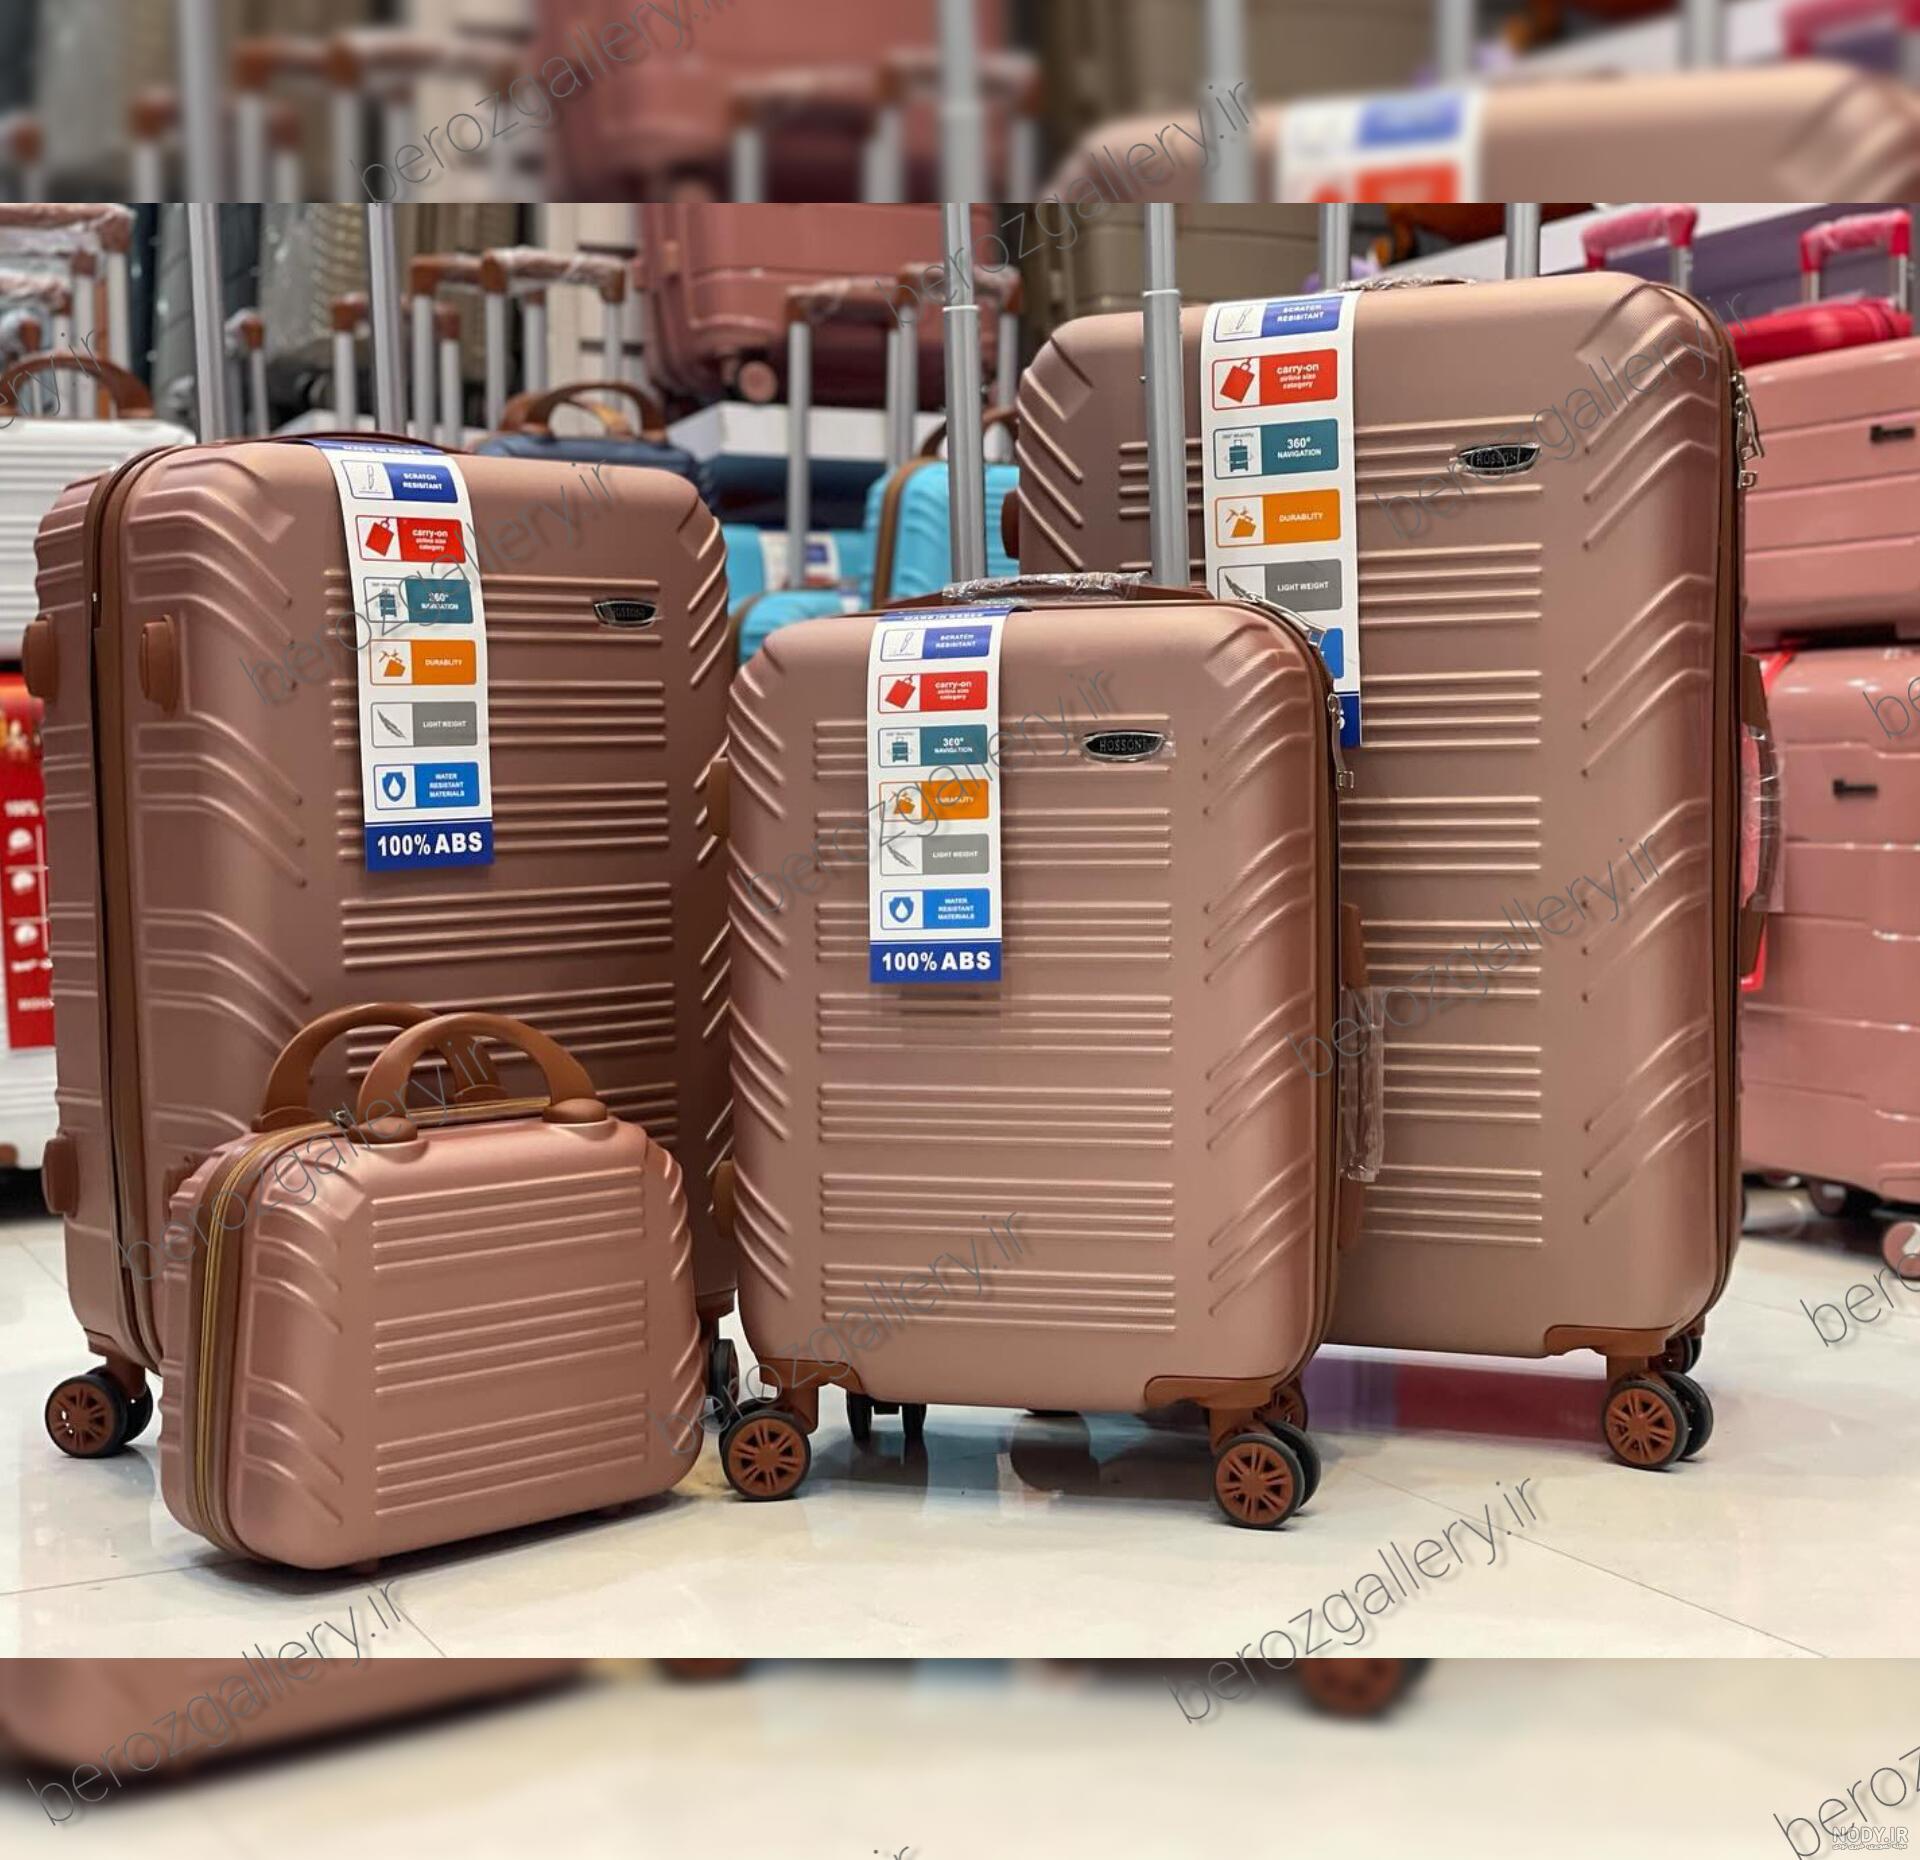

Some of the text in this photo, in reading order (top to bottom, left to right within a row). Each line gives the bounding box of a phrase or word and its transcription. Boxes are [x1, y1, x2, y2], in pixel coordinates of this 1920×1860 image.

[1276, 363, 1319, 375] carry-on
[1286, 436, 1312, 449] 360°
[1277, 448, 1322, 459] NAVIGATION
[412, 529, 448, 539] carry-on
[1277, 581, 1329, 592] LIGHT WEIGHT
[934, 680, 972, 690] carry-on
[423, 720, 467, 728] LIGHT WEIGHT
[429, 790, 465, 798] MATERIALS
[377, 831, 484, 857] 100% ABS
[953, 850, 979, 858] WEIGHT
[882, 950, 992, 972] 100% ABS
